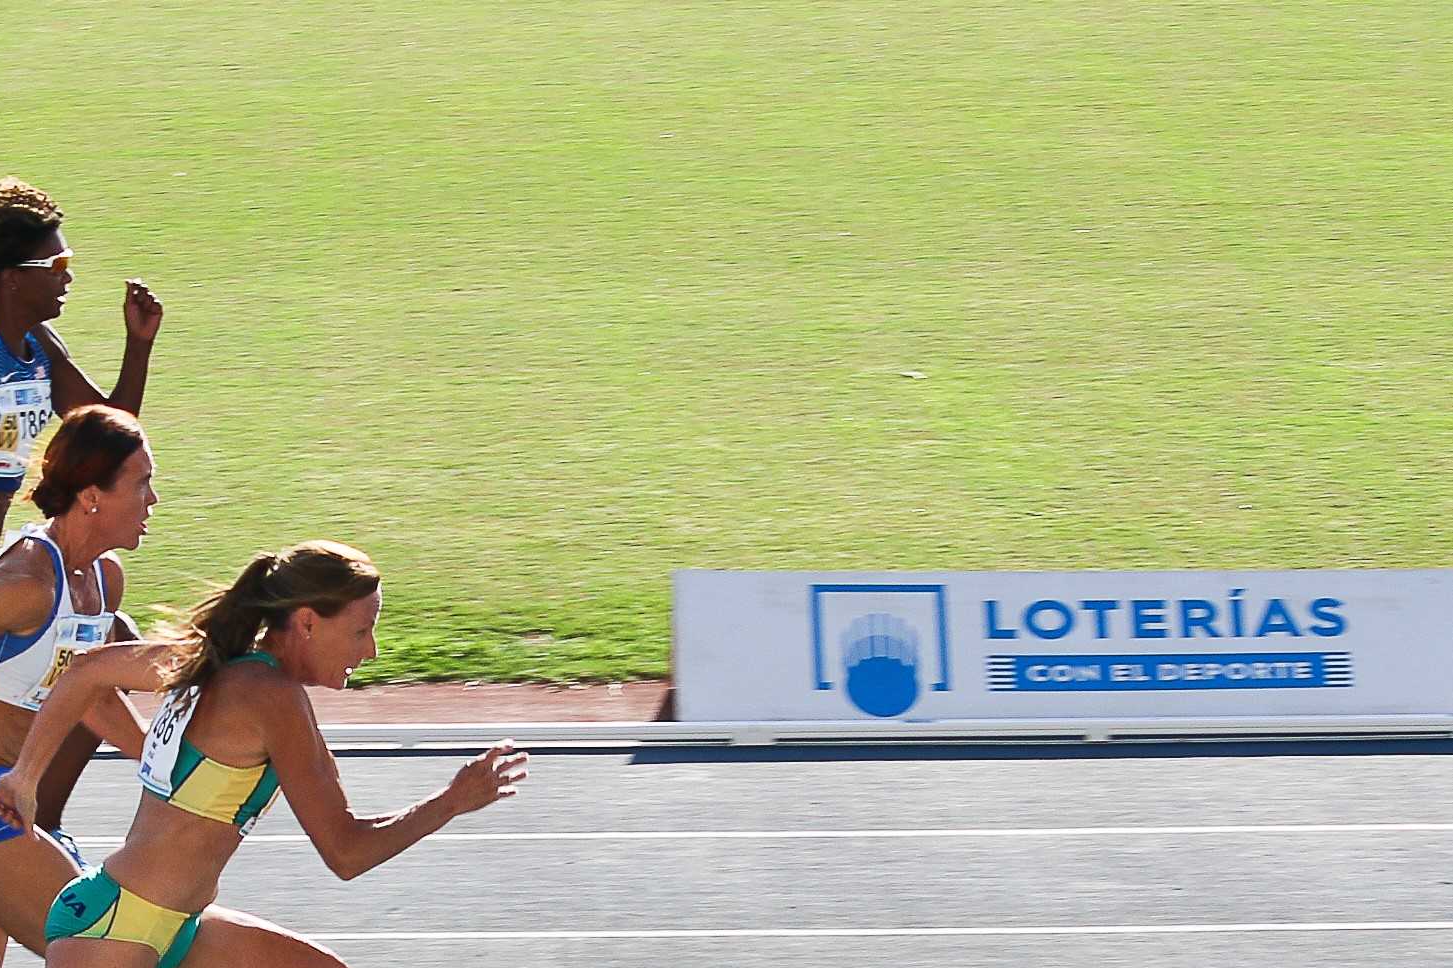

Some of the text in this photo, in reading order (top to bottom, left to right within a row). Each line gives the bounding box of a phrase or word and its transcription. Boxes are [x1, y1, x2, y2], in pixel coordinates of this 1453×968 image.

[20, 410, 52, 439] 786
[982, 588, 1348, 640] LOTERÍAS
[57, 649, 73, 666] 50
[1026, 662, 1313, 682] CON EL DEPORTE
